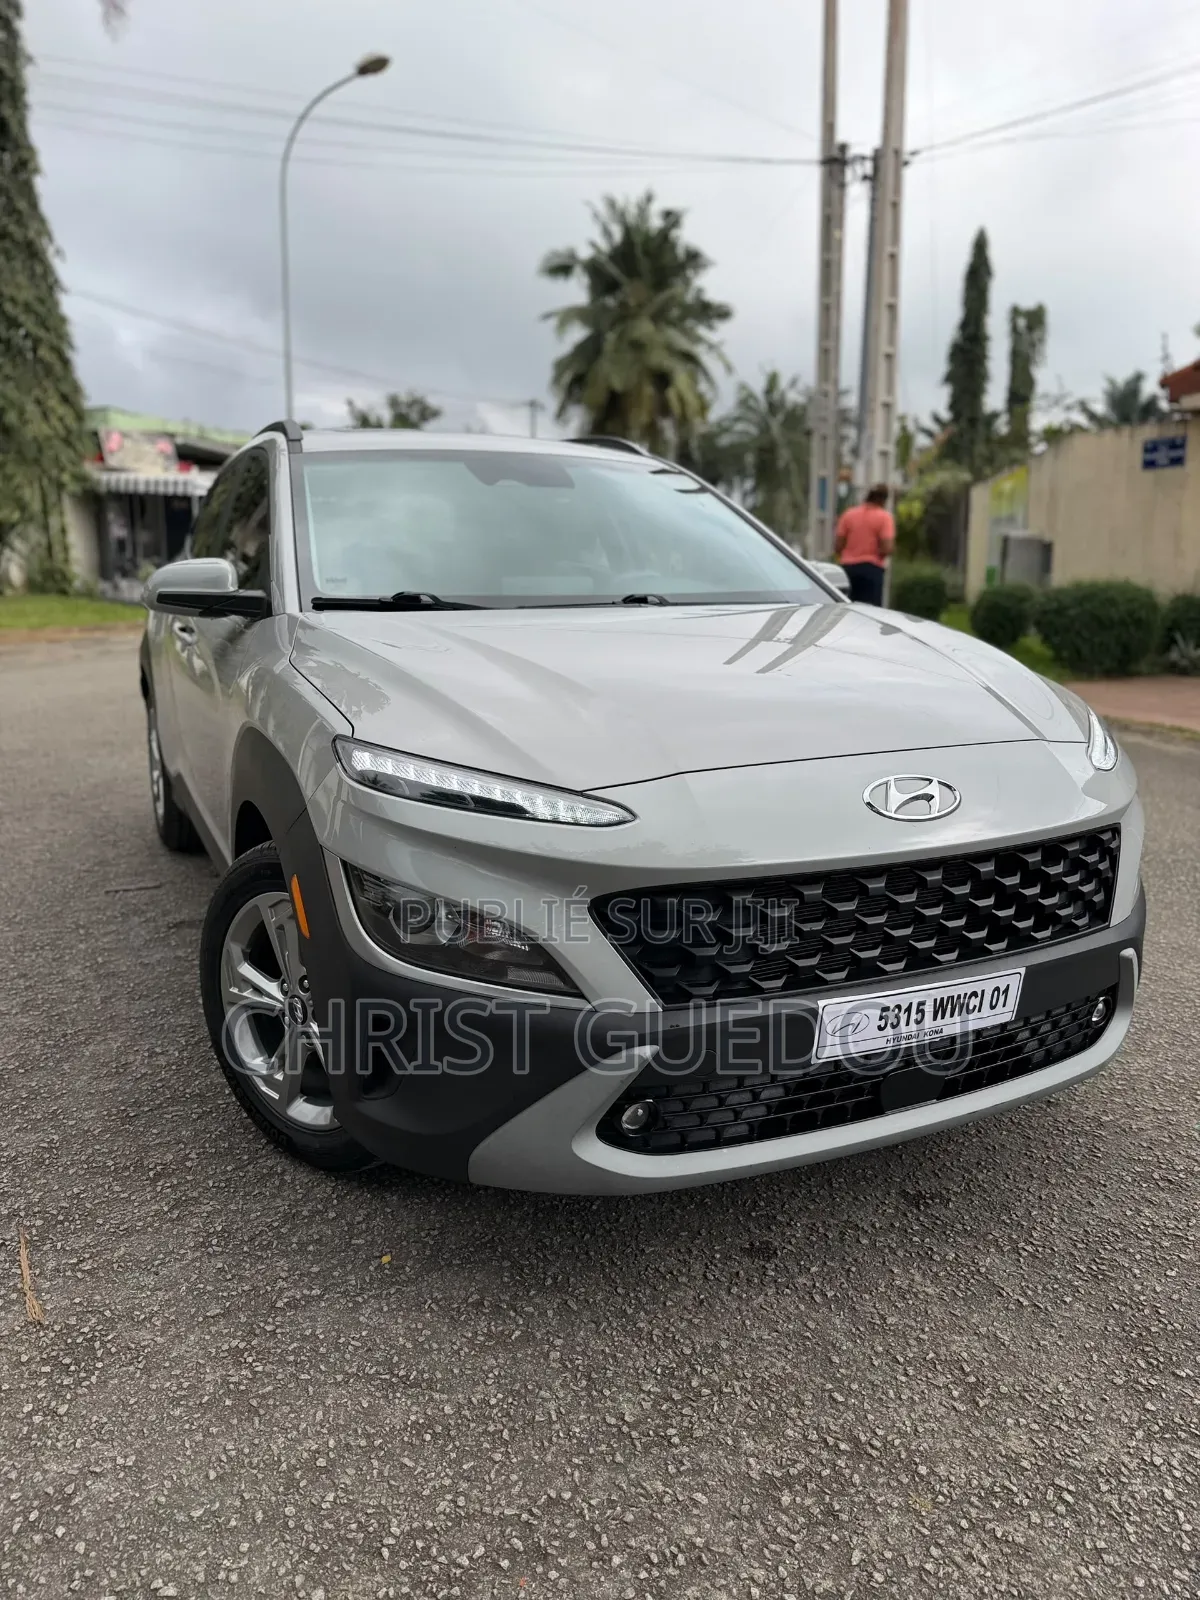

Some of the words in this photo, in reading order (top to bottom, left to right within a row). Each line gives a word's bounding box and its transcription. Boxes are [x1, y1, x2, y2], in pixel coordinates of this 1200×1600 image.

[877, 1000, 926, 1031] 5315
[932, 989, 985, 1021] WWCI
[989, 984, 1010, 1010] 01
[886, 1032, 920, 1044] HYUNDAI
[923, 1028, 943, 1038] KONA
